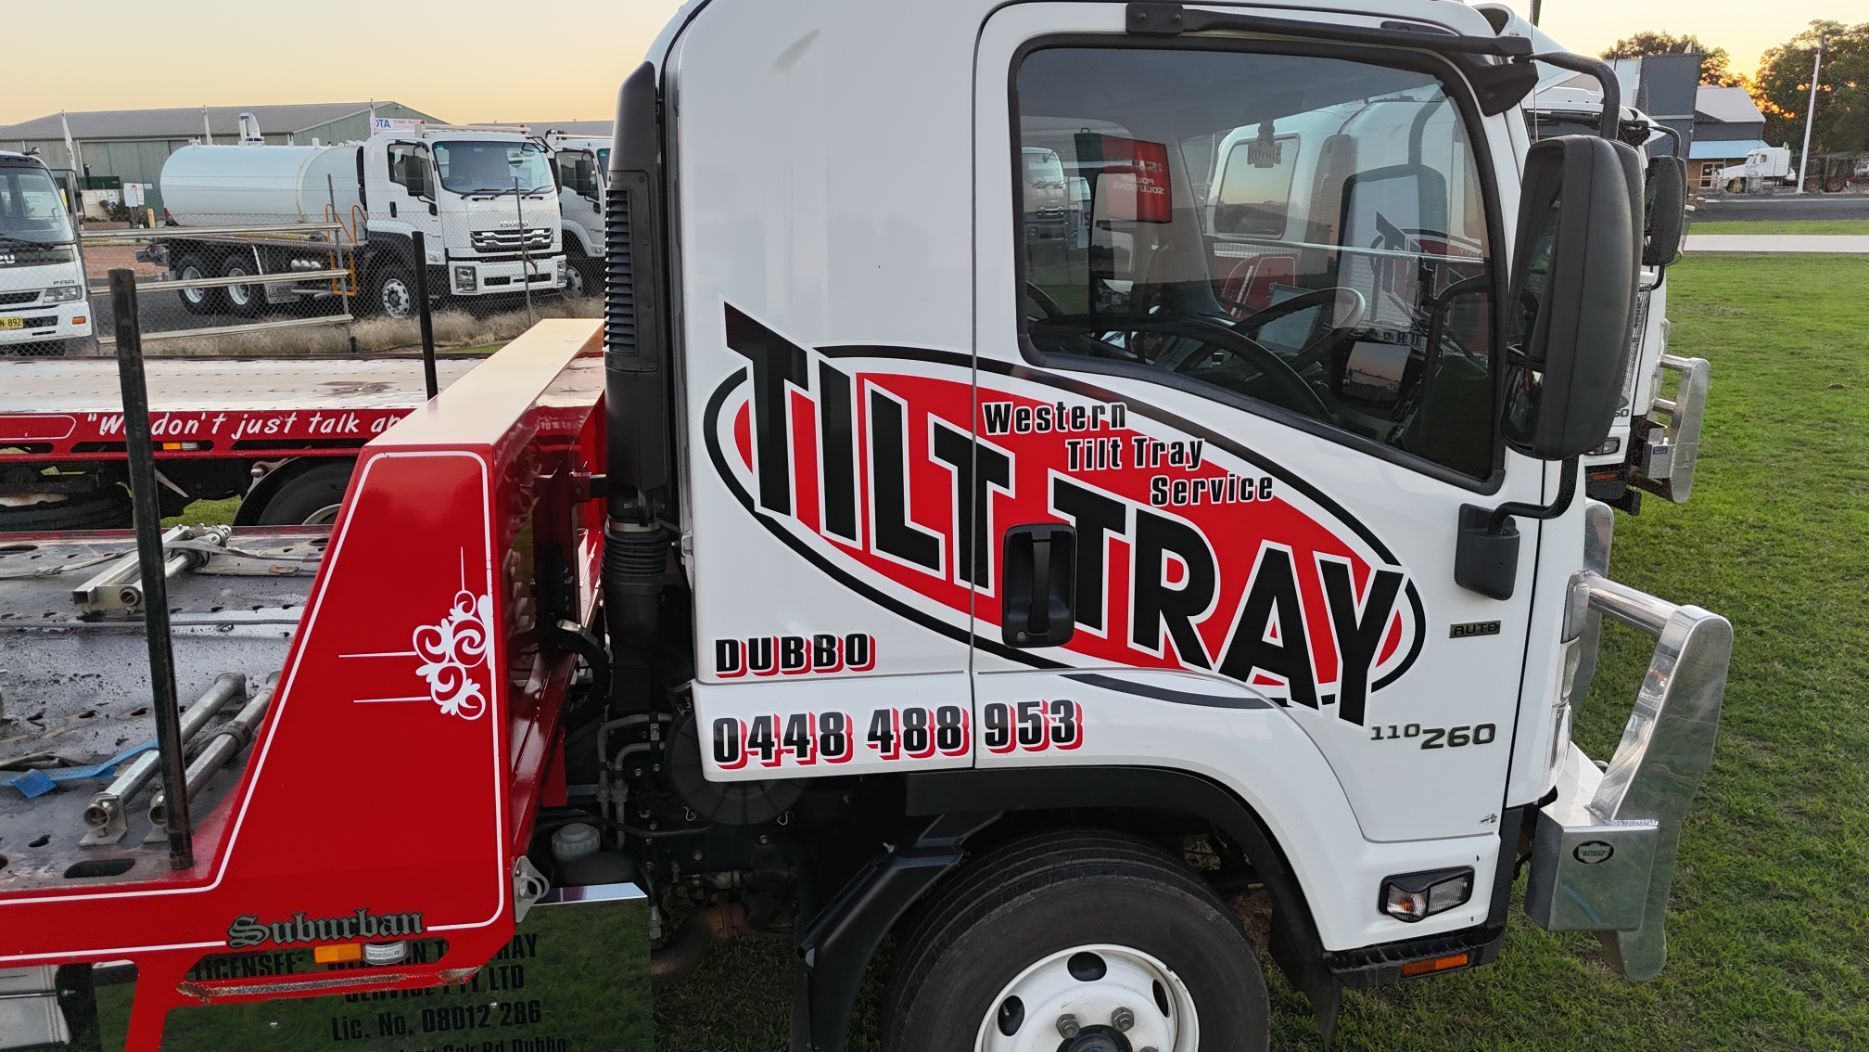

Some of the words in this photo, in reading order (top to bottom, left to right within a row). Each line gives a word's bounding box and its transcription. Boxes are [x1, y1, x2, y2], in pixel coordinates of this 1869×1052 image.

[151, 412, 227, 437] don't
[231, 411, 298, 439] just
[308, 411, 360, 435] talk
[983, 401, 1127, 435] Western
[1066, 438, 1122, 471] Tilt
[1132, 436, 1205, 470] Tray
[1150, 473, 1274, 507] Service
[724, 300, 1013, 598] TILT
[1052, 477, 1405, 726] TRAY
[1453, 621, 1498, 637] AUTO
[715, 633, 876, 679] DUBBO
[712, 711, 854, 770] 0448
[866, 705, 970, 761] 488
[983, 699, 1083, 754] 953
[227, 908, 424, 949] Suburban
[488, 964, 525, 991] LTD
[331, 1016, 370, 1041] Lic.
[378, 1011, 414, 1038] No.
[422, 1004, 492, 1033] 08012
[498, 1000, 542, 1026] 286
